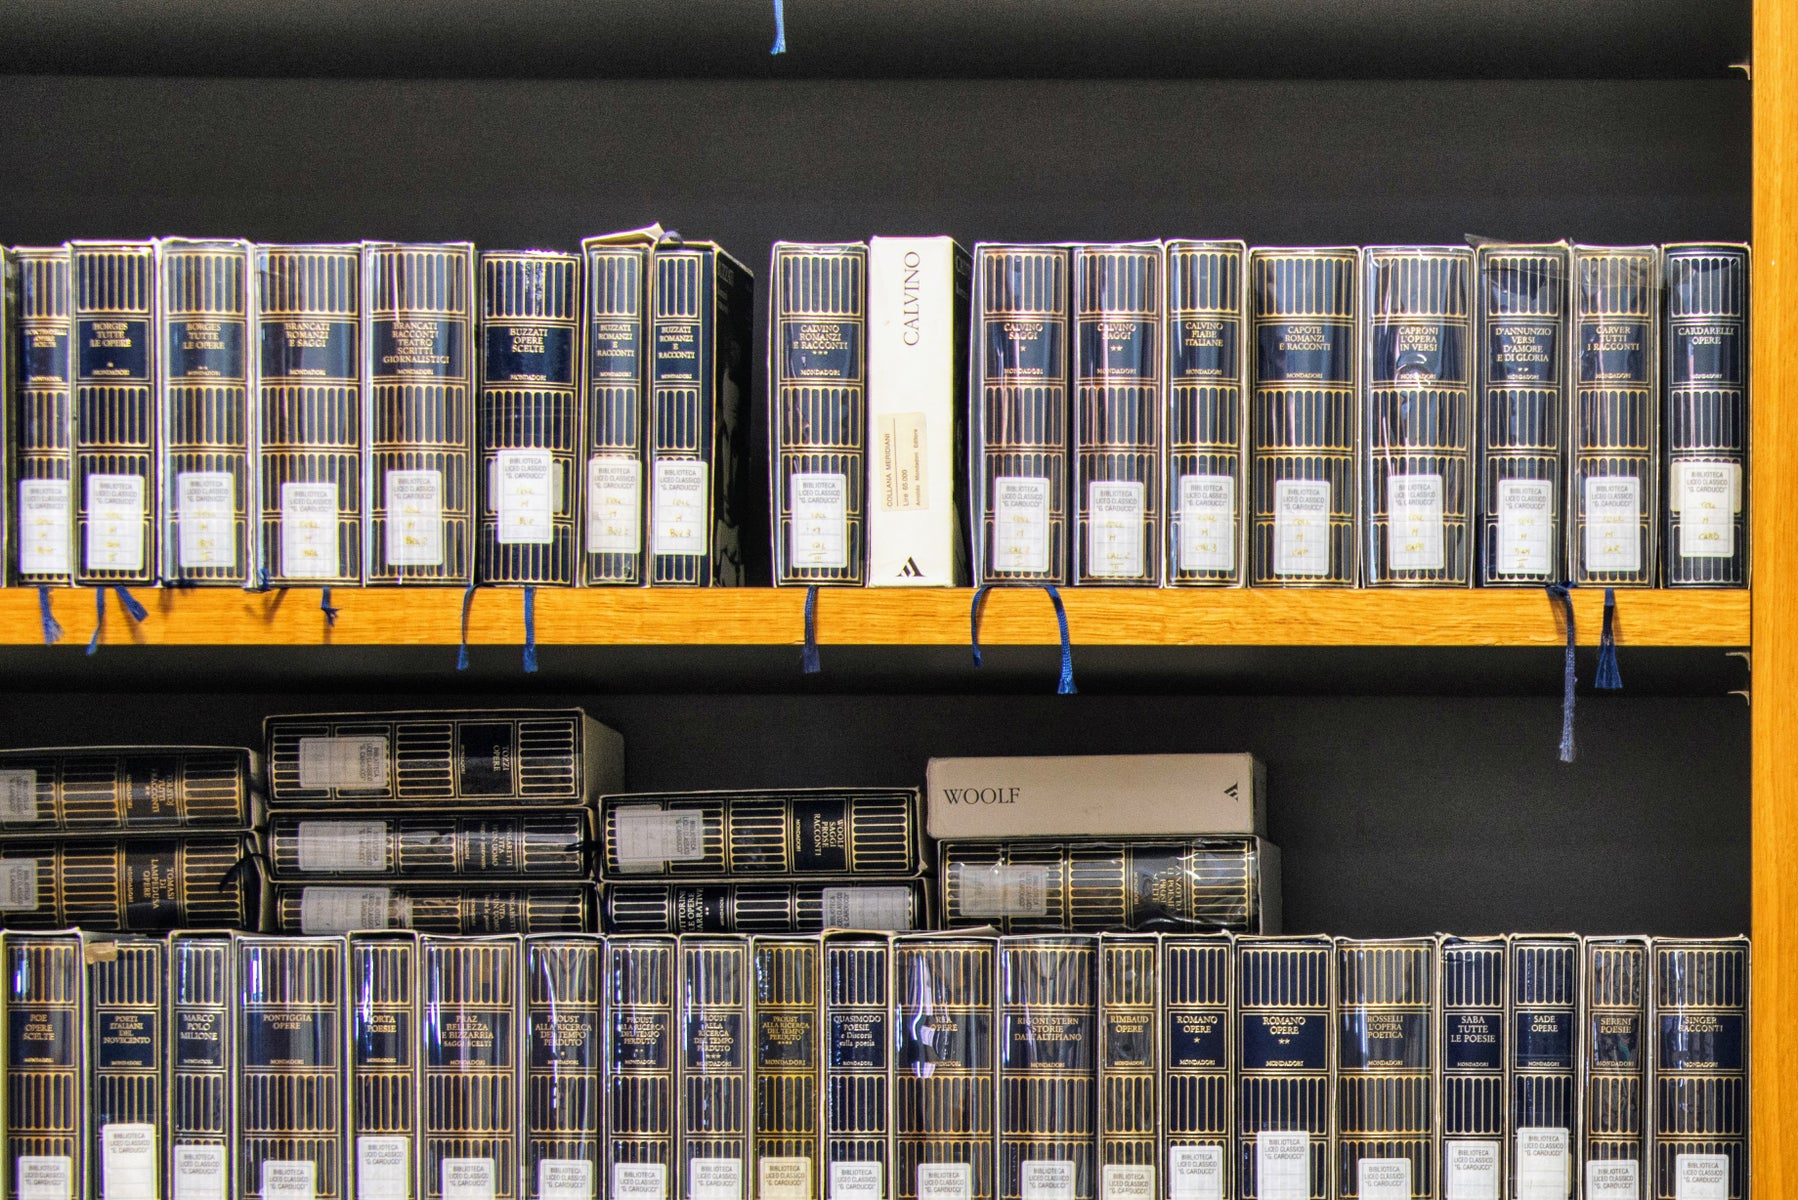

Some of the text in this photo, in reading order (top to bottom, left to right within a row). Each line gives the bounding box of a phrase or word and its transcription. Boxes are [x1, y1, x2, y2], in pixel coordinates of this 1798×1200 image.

[903, 250, 918, 347] CALVINO
[1186, 322, 1224, 330] CALVINO
[1288, 326, 1322, 334] CAPOTE
[510, 328, 548, 337] BUZZATI
[1678, 327, 1734, 336] CARDARELLI
[514, 337, 544, 345] OPERE
[1186, 339, 1224, 347] ITALIANE
[1692, 337, 1722, 345] OPERE
[513, 345, 545, 353] SCELTE
[1279, 343, 1331, 351] E RACCONTI
[943, 787, 1020, 805] WOOLF
[1176, 1016, 1218, 1024] ROMANO
[1462, 1016, 1486, 1024] SABA
[1183, 1025, 1211, 1034] OPERE
[1458, 1025, 1488, 1033] TUTTE
[1451, 1034, 1496, 1043] LE POESIE
